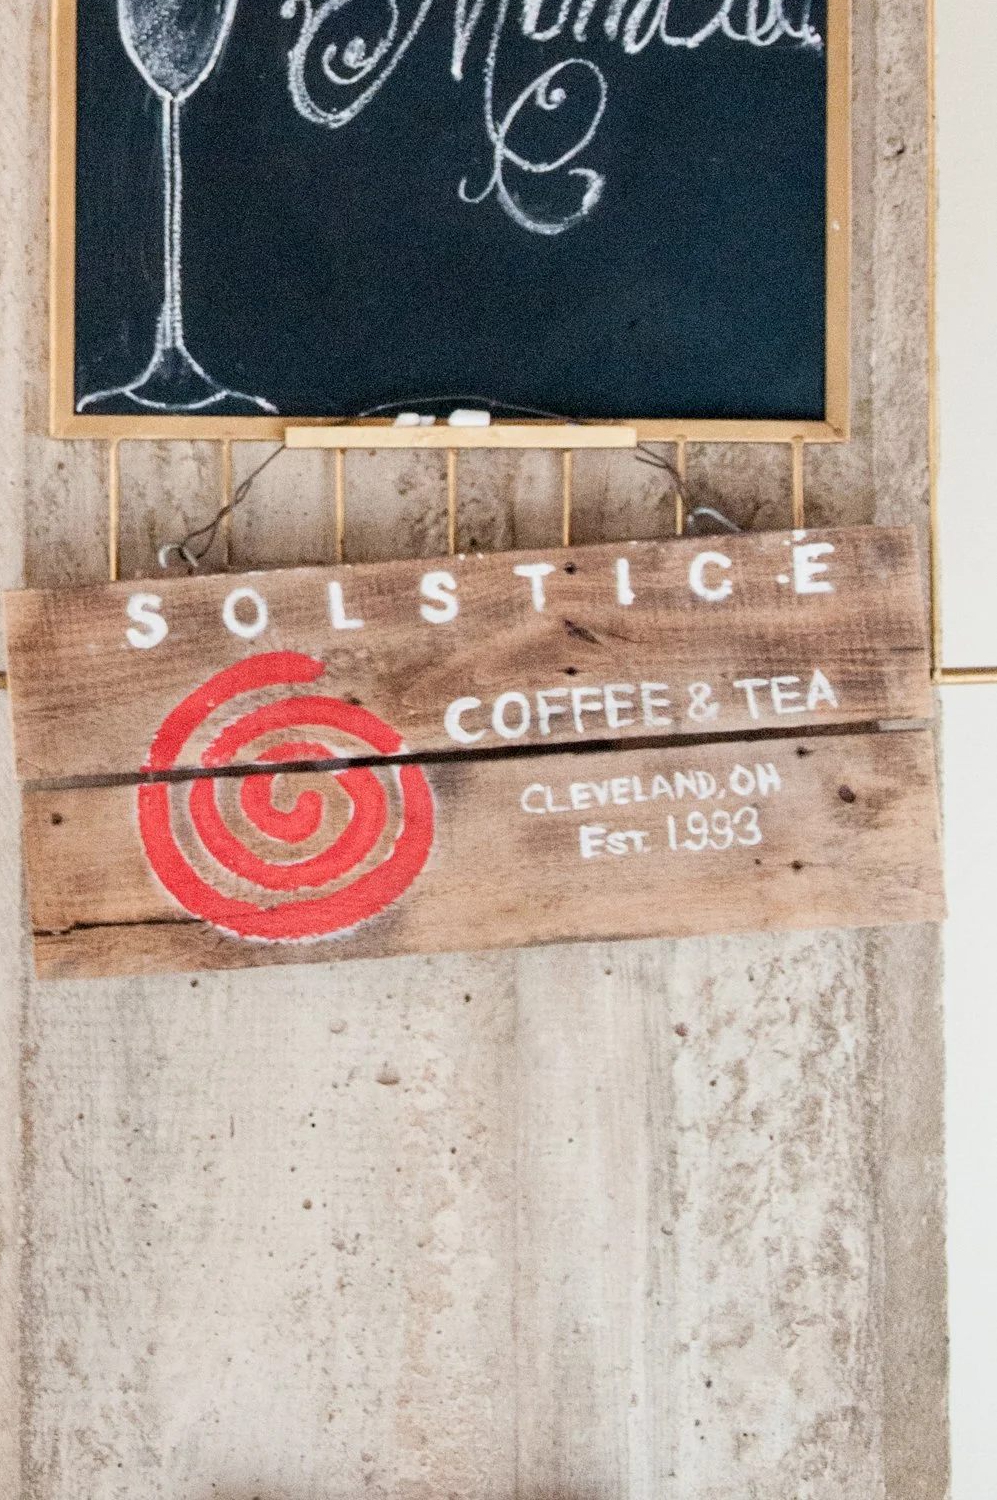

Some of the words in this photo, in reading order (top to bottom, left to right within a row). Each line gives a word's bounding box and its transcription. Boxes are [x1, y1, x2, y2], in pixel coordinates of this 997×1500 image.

[125, 541, 836, 650] SOLSTICE
[443, 680, 672, 745] COFFEE
[686, 682, 720, 723] &
[733, 668, 839, 721] TEA
[666, 805, 764, 853] 1993
